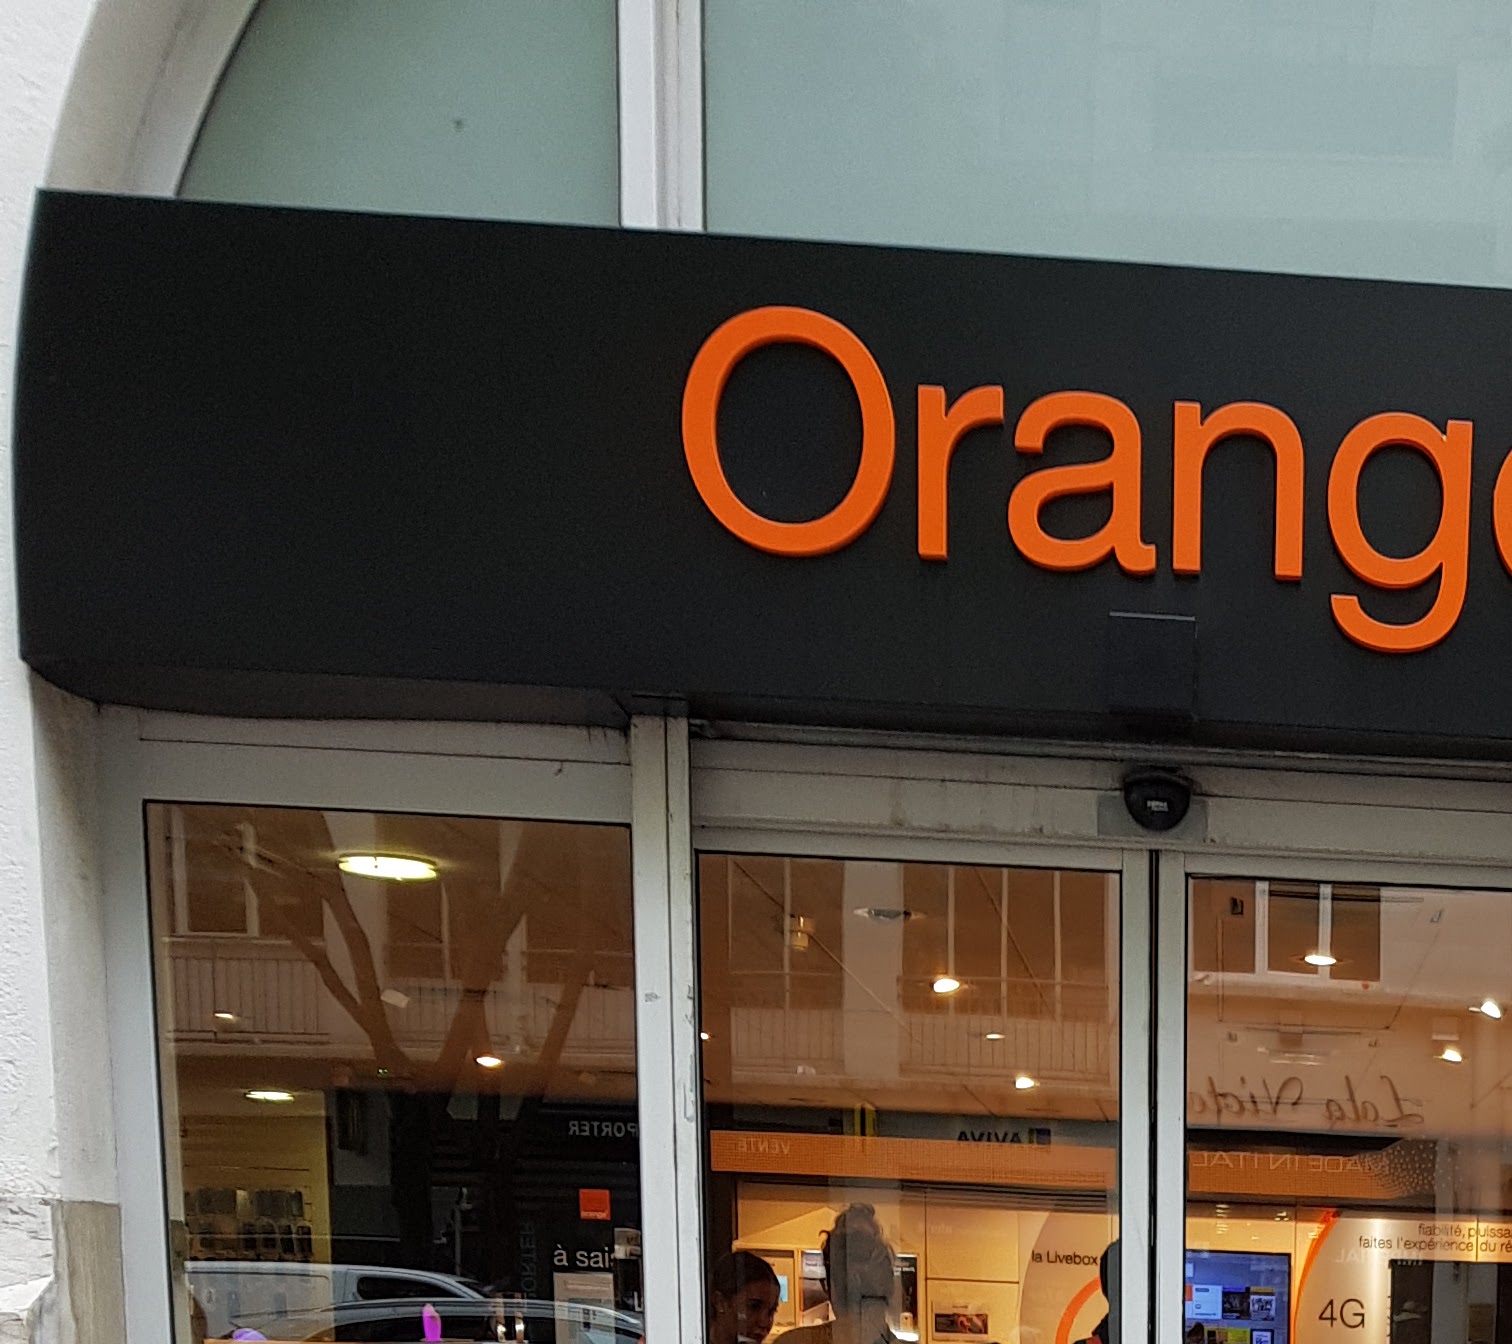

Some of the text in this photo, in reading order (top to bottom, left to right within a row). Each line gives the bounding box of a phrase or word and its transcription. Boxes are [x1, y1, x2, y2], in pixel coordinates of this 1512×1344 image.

[1358, 1235, 1393, 1250] faites
[1480, 1239, 1497, 1252] du
[553, 1243, 569, 1267] à
[1031, 1249, 1098, 1266] la Livebox
[1318, 1297, 1366, 1329] 4G
